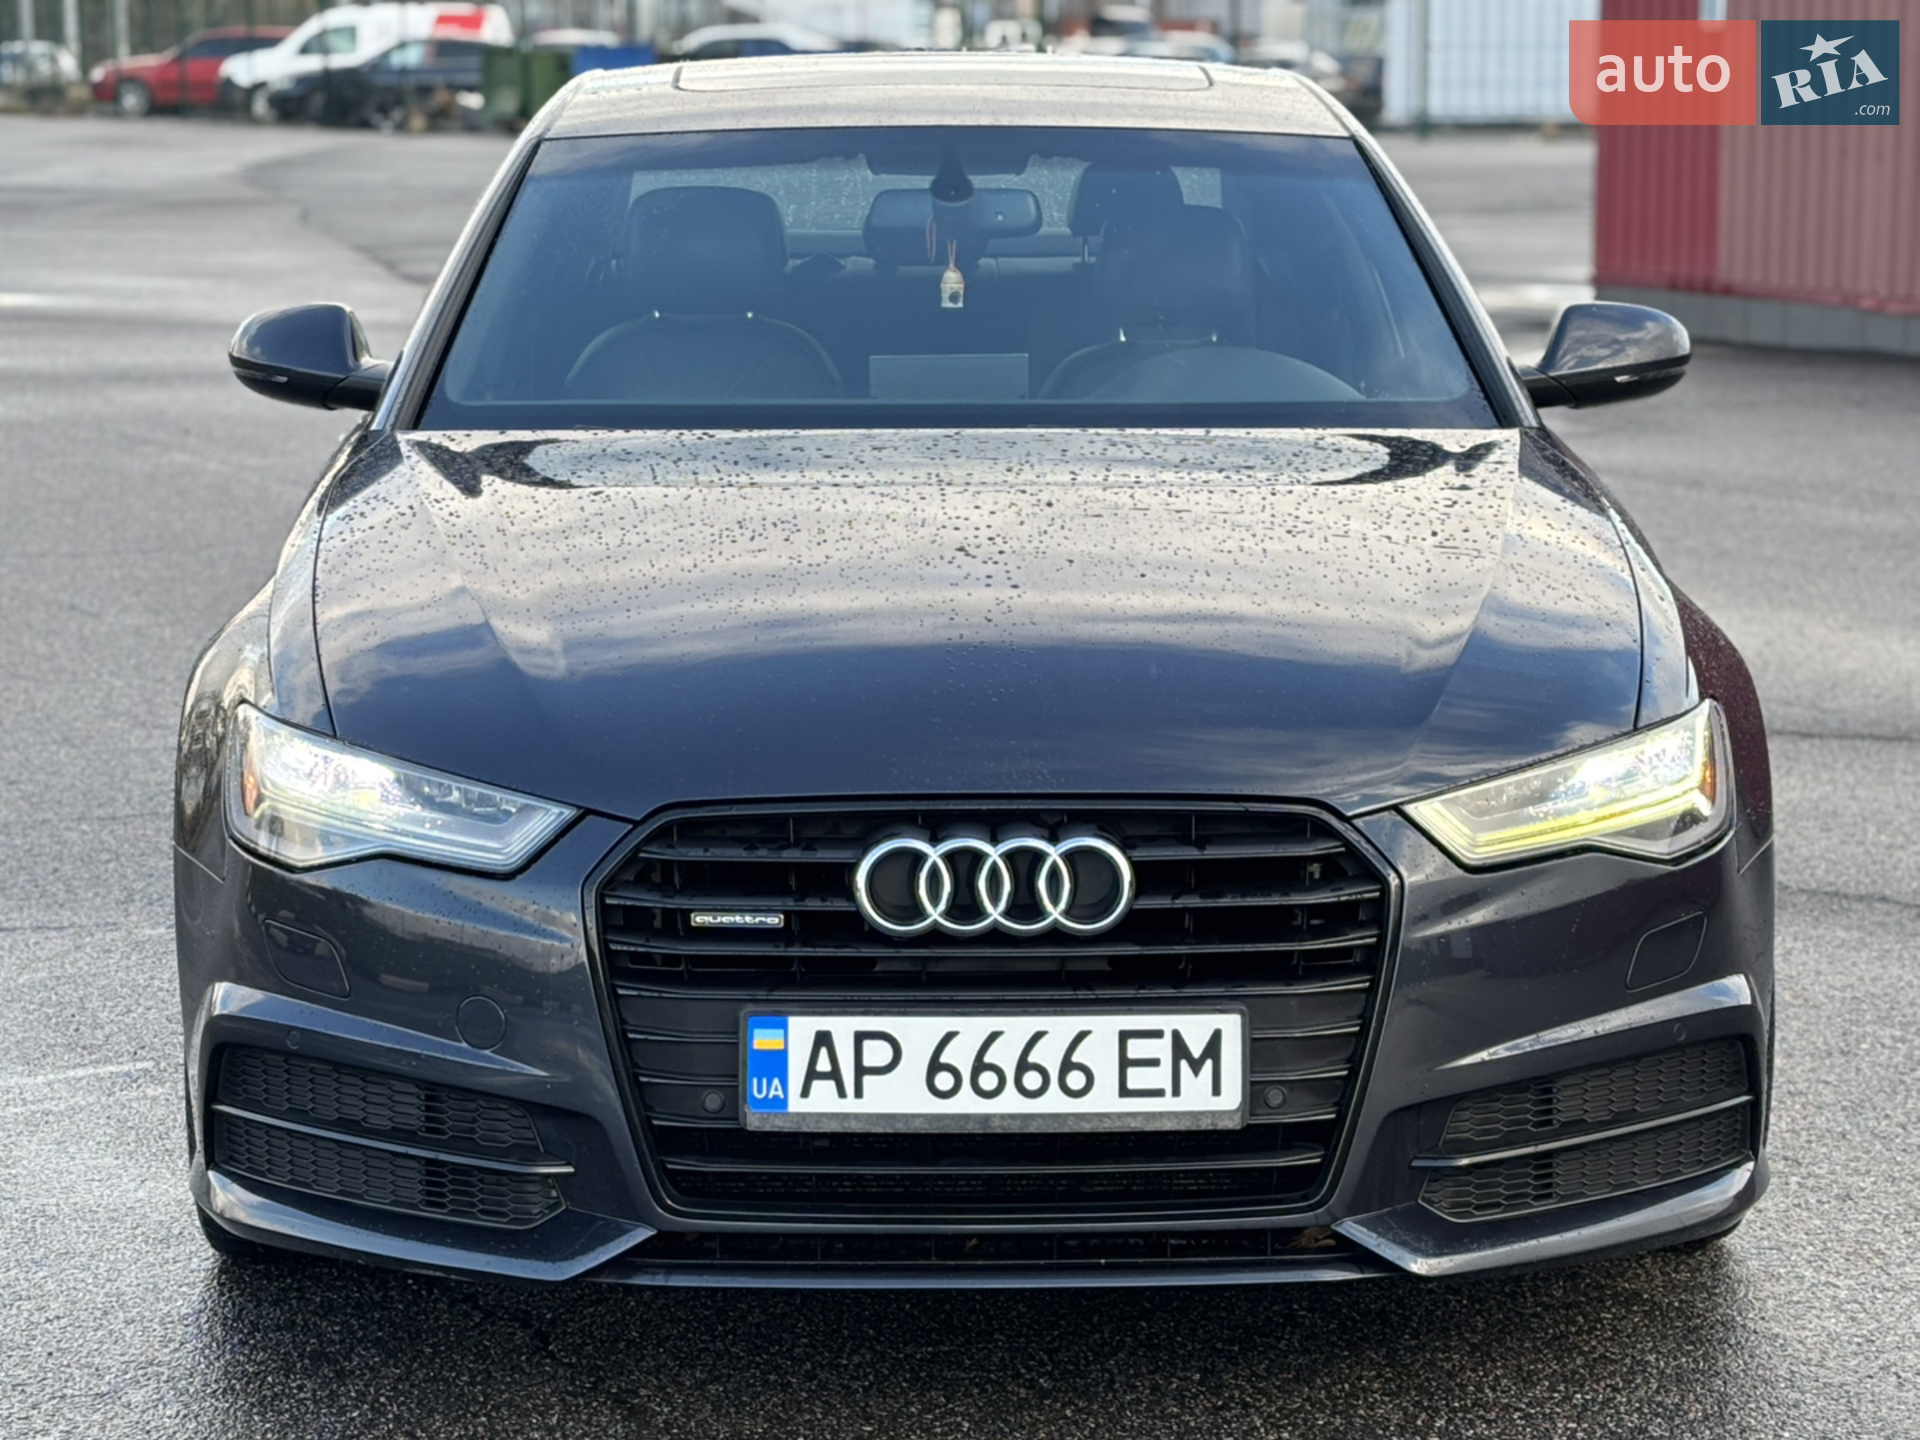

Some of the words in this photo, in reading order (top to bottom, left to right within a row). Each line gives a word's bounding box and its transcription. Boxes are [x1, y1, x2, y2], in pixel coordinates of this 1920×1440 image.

[695, 915, 780, 925] quattro
[799, 1029, 903, 1100] AP
[925, 1029, 1095, 1100] 6666
[1118, 1028, 1223, 1098] EM
[752, 1077, 785, 1100] UA
